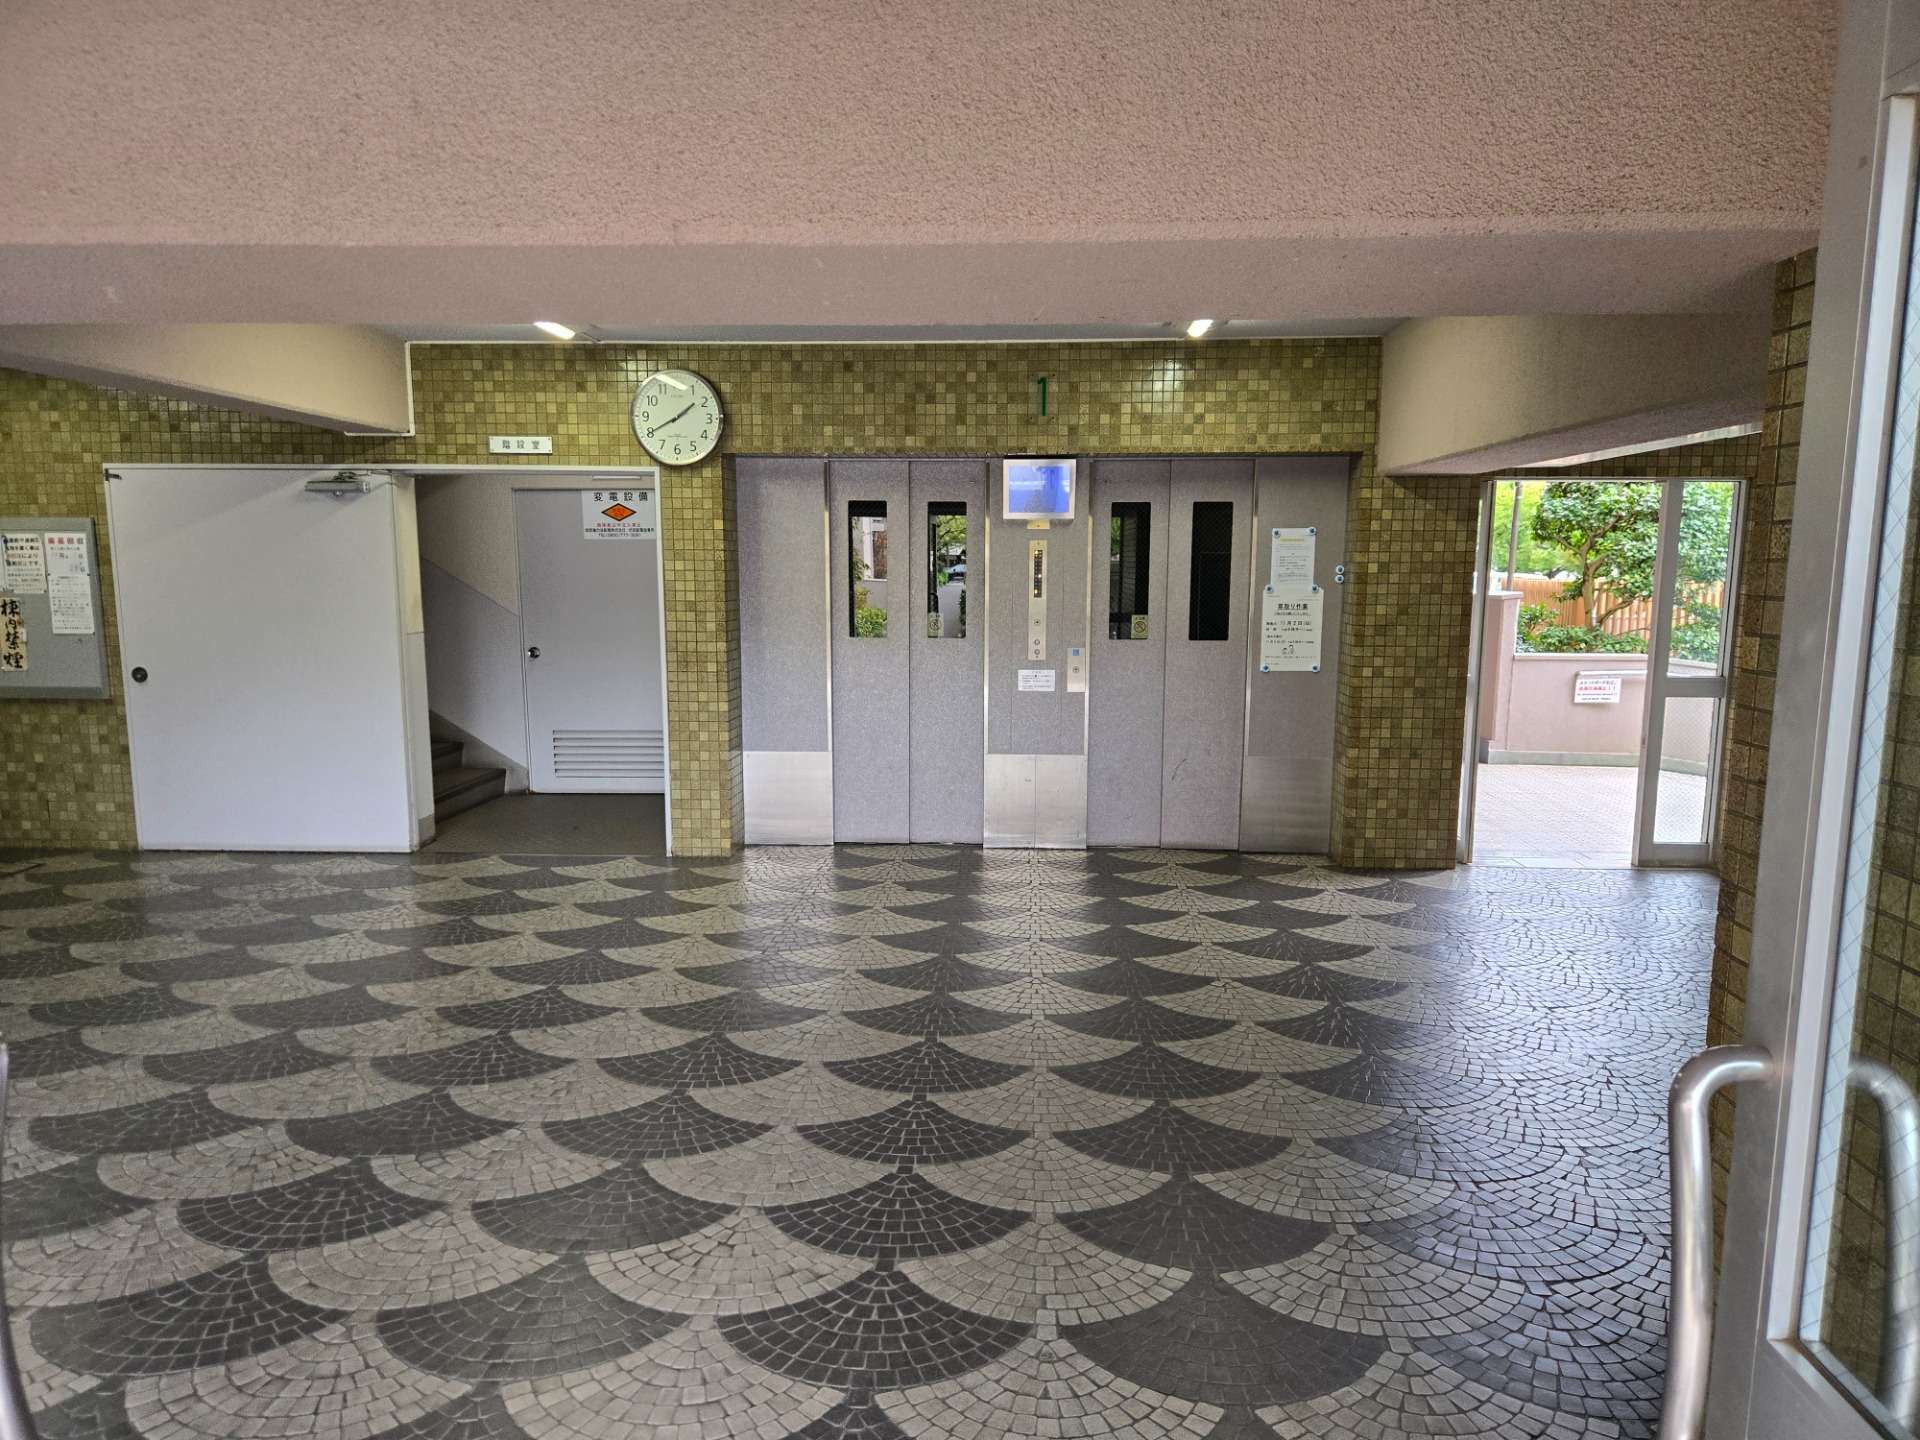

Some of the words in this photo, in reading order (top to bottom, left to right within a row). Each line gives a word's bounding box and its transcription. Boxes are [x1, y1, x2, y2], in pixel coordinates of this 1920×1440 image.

[658, 383, 668, 396] 11
[690, 384, 696, 397] 1
[647, 395, 658, 407] 10
[701, 396, 708, 408] 2
[1037, 377, 1047, 417] 1
[642, 411, 649, 423] 9
[706, 413, 713, 424] 3
[646, 427, 655, 438] 8
[701, 429, 708, 440] 4
[659, 439, 666, 450] 7
[674, 443, 682, 455] 6
[690, 440, 697, 452] 5
[593, 492, 649, 502] 変電設備
